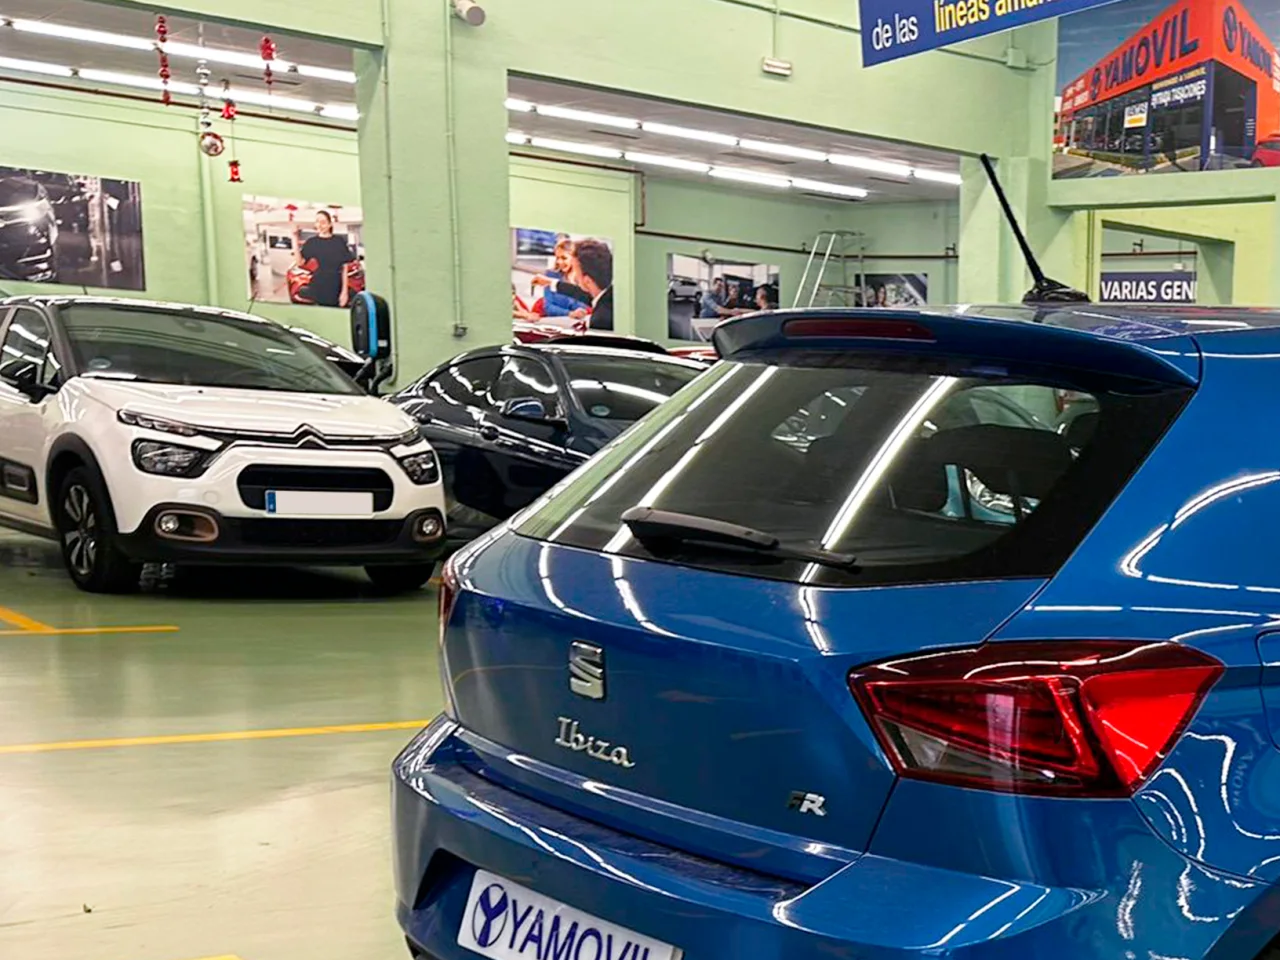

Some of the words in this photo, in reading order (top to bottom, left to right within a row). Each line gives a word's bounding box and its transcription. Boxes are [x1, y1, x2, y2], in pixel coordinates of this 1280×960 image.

[872, 18, 893, 50] de
[895, 13, 919, 45] las
[933, 0, 990, 33] líneas
[1105, 8, 1200, 91] YAMOVIL
[1100, 280, 1157, 300] VARIAS
[554, 717, 635, 769] Ibiza
